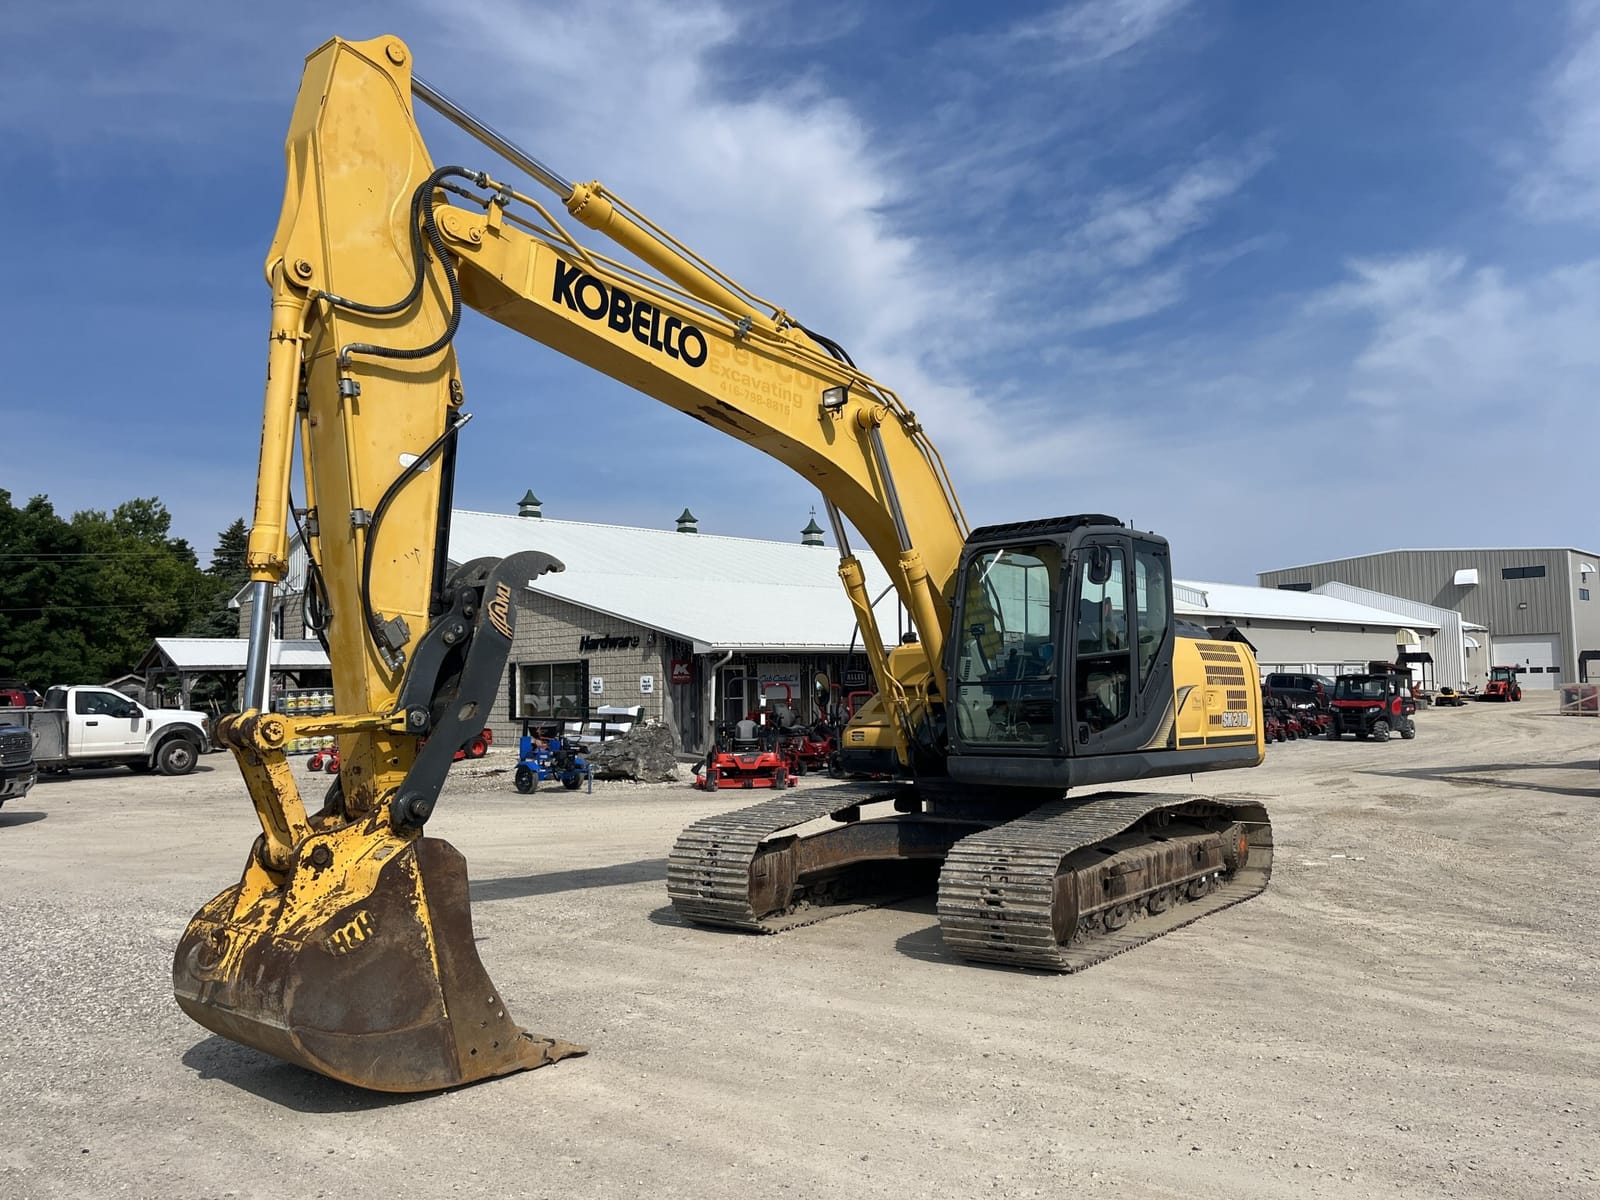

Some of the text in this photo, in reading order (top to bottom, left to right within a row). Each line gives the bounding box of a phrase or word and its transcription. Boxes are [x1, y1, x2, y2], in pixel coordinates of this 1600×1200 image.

[552, 258, 707, 368] KOBELCO
[710, 357, 803, 408] Excavating
[580, 635, 640, 650] Hardware
